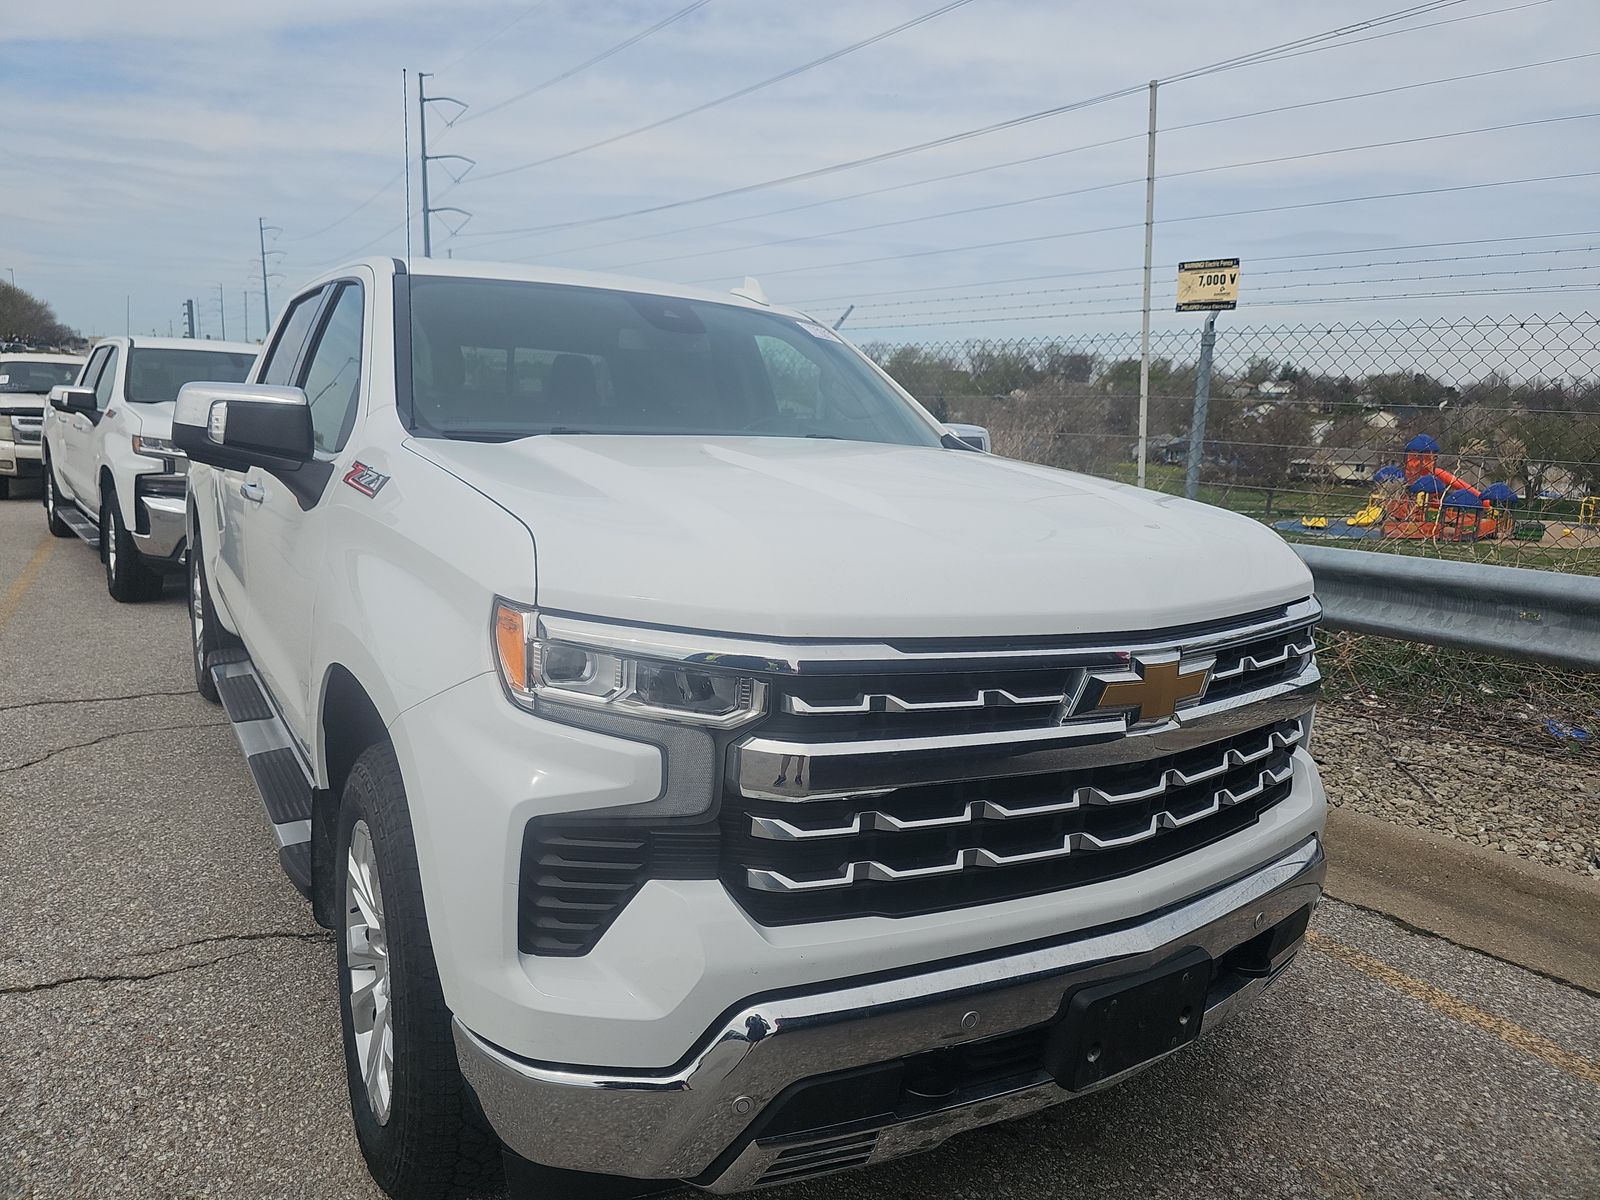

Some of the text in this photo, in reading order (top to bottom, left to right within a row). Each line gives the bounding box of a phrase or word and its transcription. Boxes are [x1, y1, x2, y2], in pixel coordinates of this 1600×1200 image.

[1199, 273, 1237, 288] 7,000 V
[343, 460, 391, 499] Z71
